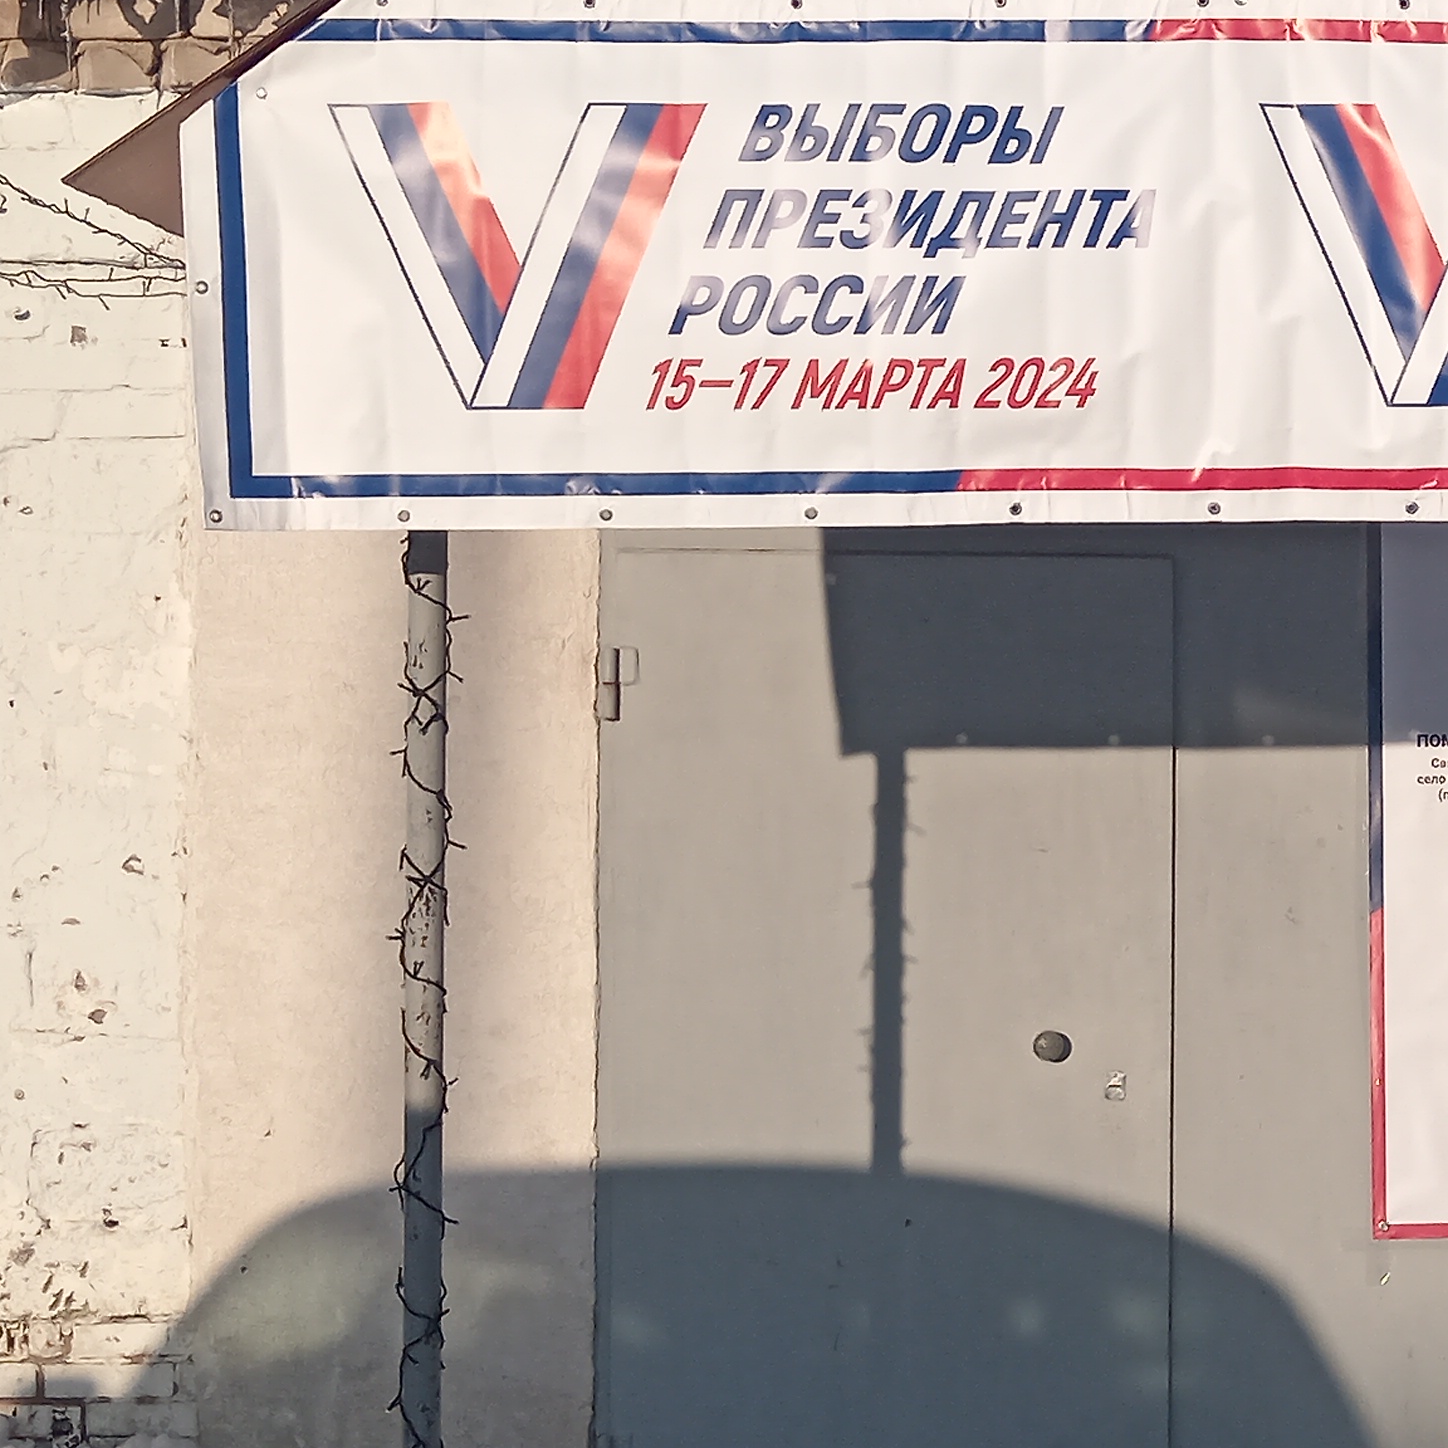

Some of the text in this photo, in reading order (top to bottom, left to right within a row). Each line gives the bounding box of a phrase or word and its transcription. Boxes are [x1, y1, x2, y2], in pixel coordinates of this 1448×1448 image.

[738, 103, 1065, 165] ВЫБОРЫ
[702, 188, 1157, 258] ПРЕЗИДЕНТА
[668, 274, 966, 335] РОССИИ
[792, 357, 969, 410] МАРТА
[974, 357, 1100, 410] 2024
[1417, 774, 1446, 784] село
